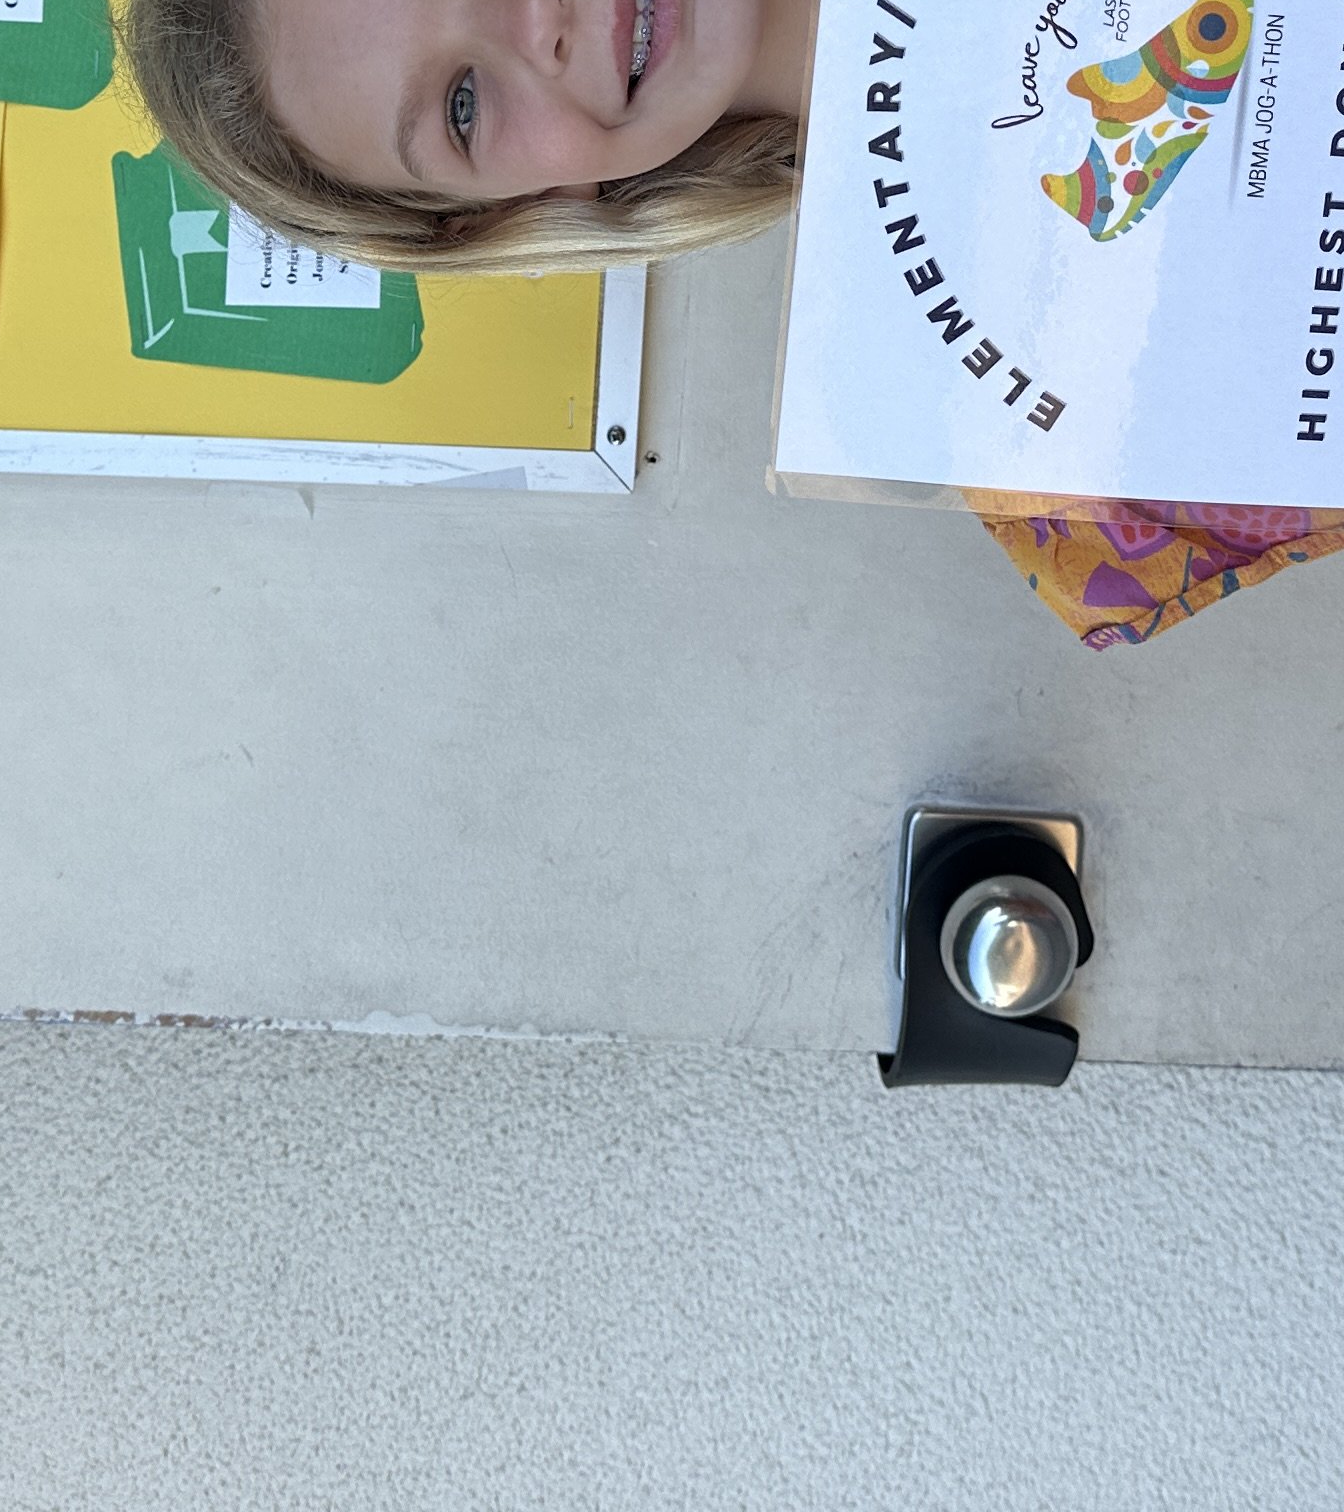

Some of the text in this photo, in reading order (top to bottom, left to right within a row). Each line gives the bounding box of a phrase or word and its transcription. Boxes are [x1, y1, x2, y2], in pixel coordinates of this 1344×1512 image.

[990, 35, 1044, 130] leave
[1246, 14, 1285, 199] MBMA JOG-A-THON
[260, 232, 273, 289] Creativ
